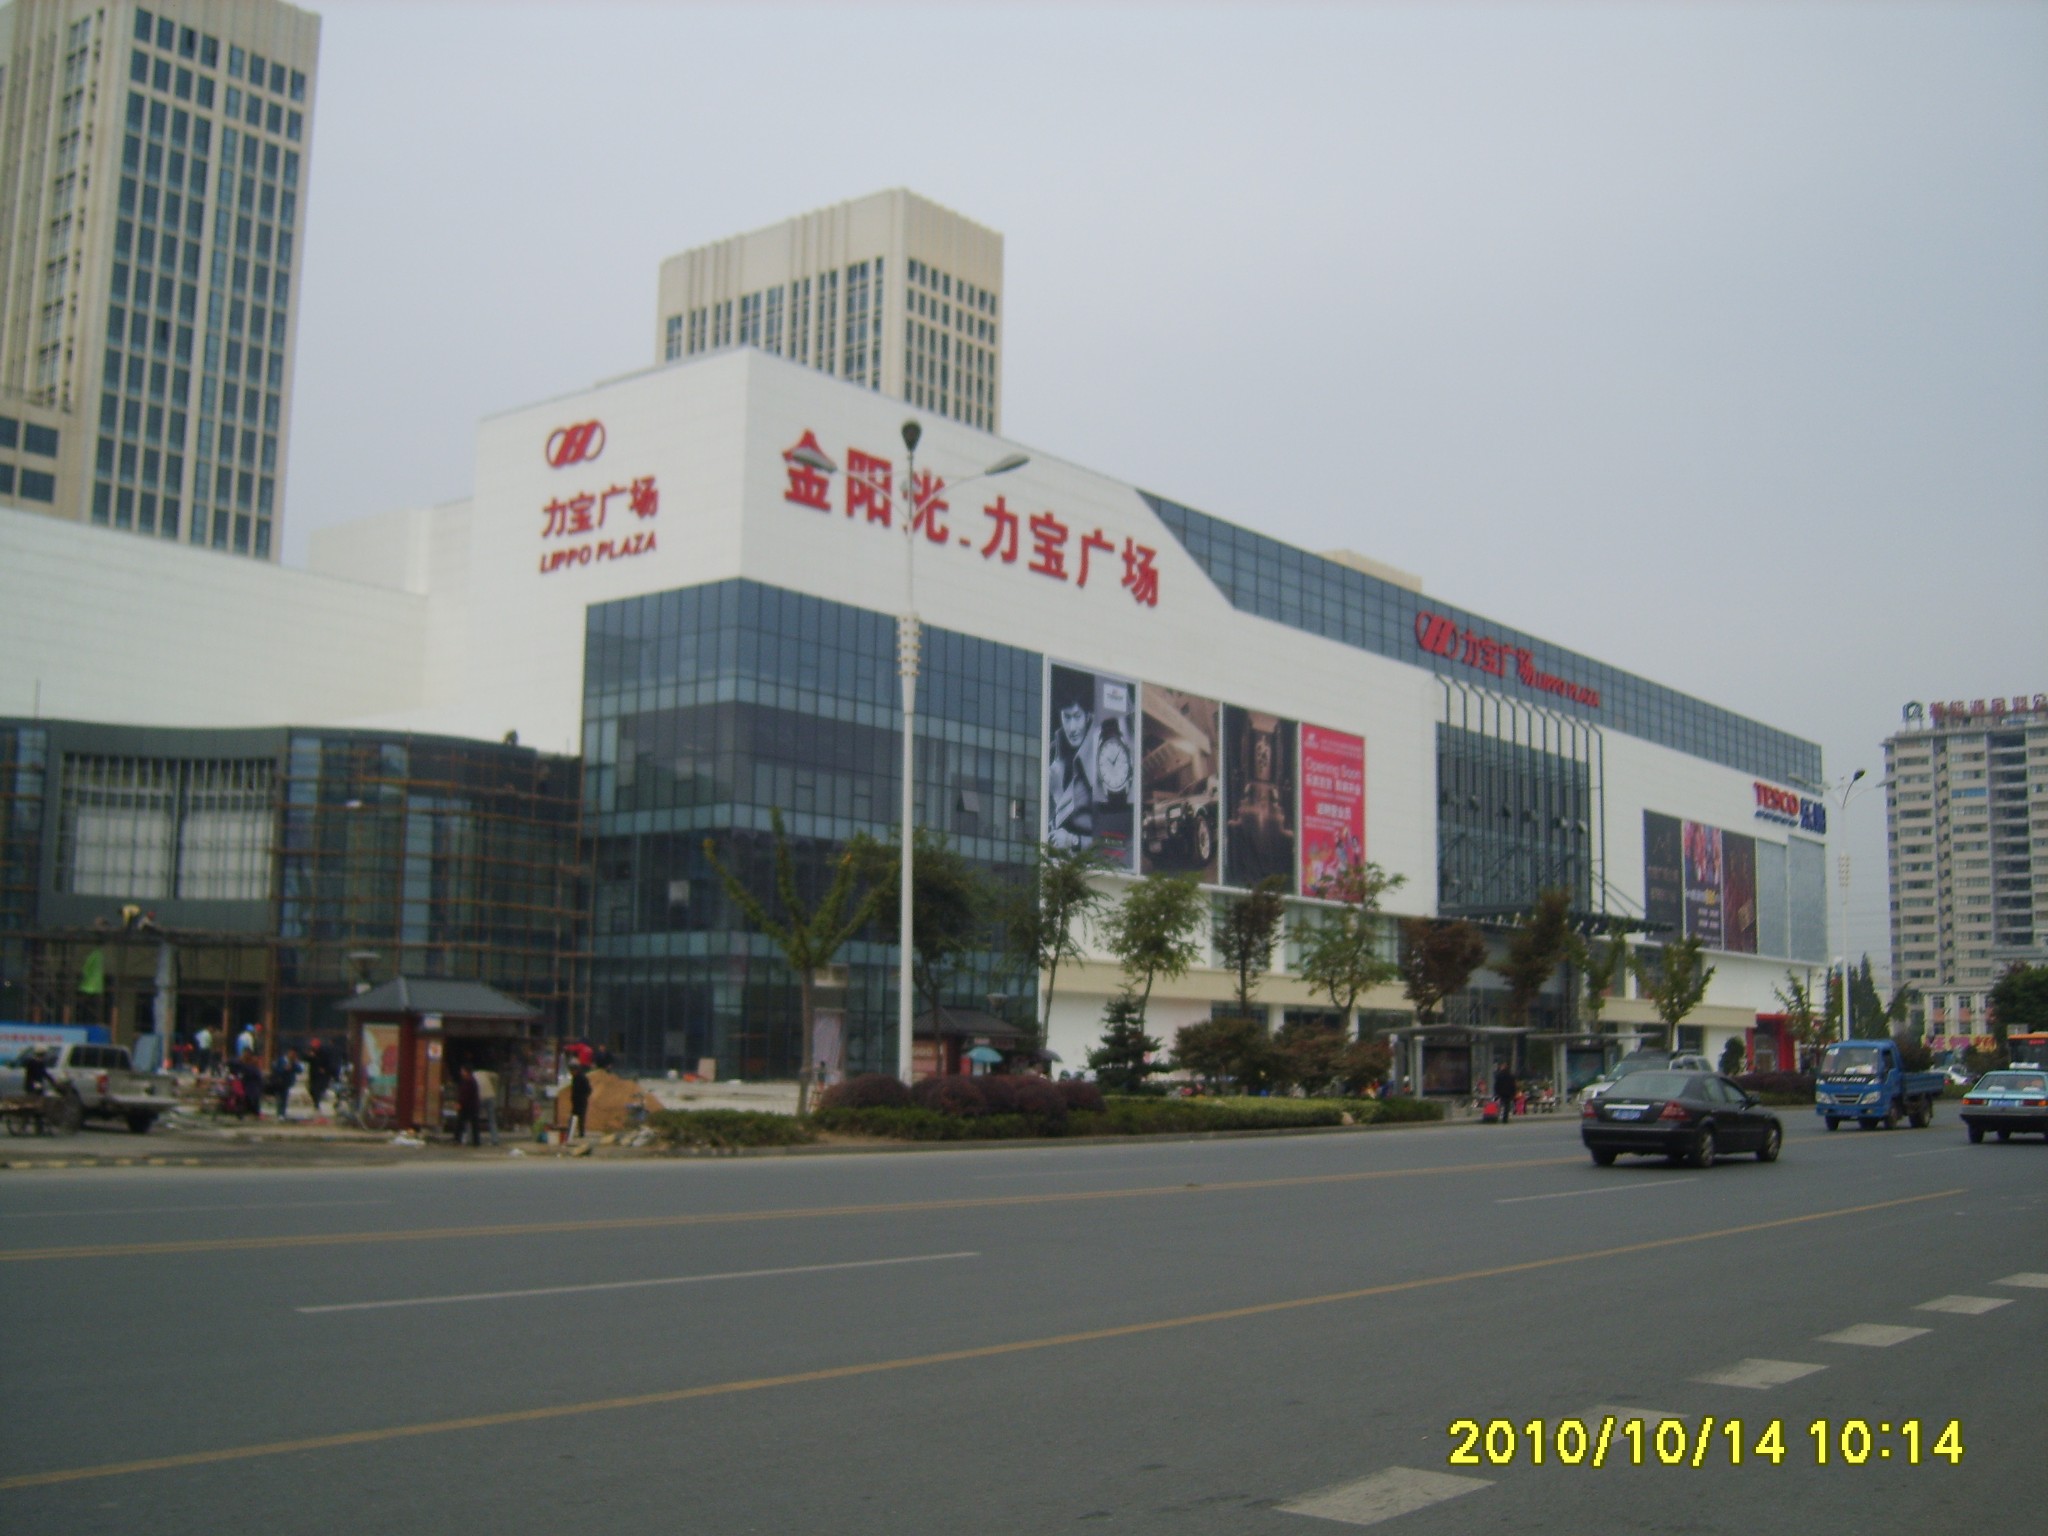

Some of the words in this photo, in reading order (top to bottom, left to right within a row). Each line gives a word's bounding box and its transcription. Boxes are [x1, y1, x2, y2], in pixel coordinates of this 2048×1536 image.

[542, 475, 659, 538] 力宝广场
[539, 544, 592, 574] LIPPO
[597, 530, 657, 561] PLAZA
[1461, 628, 1536, 688] 力宝广场
[1753, 781, 1799, 817] TESCO
